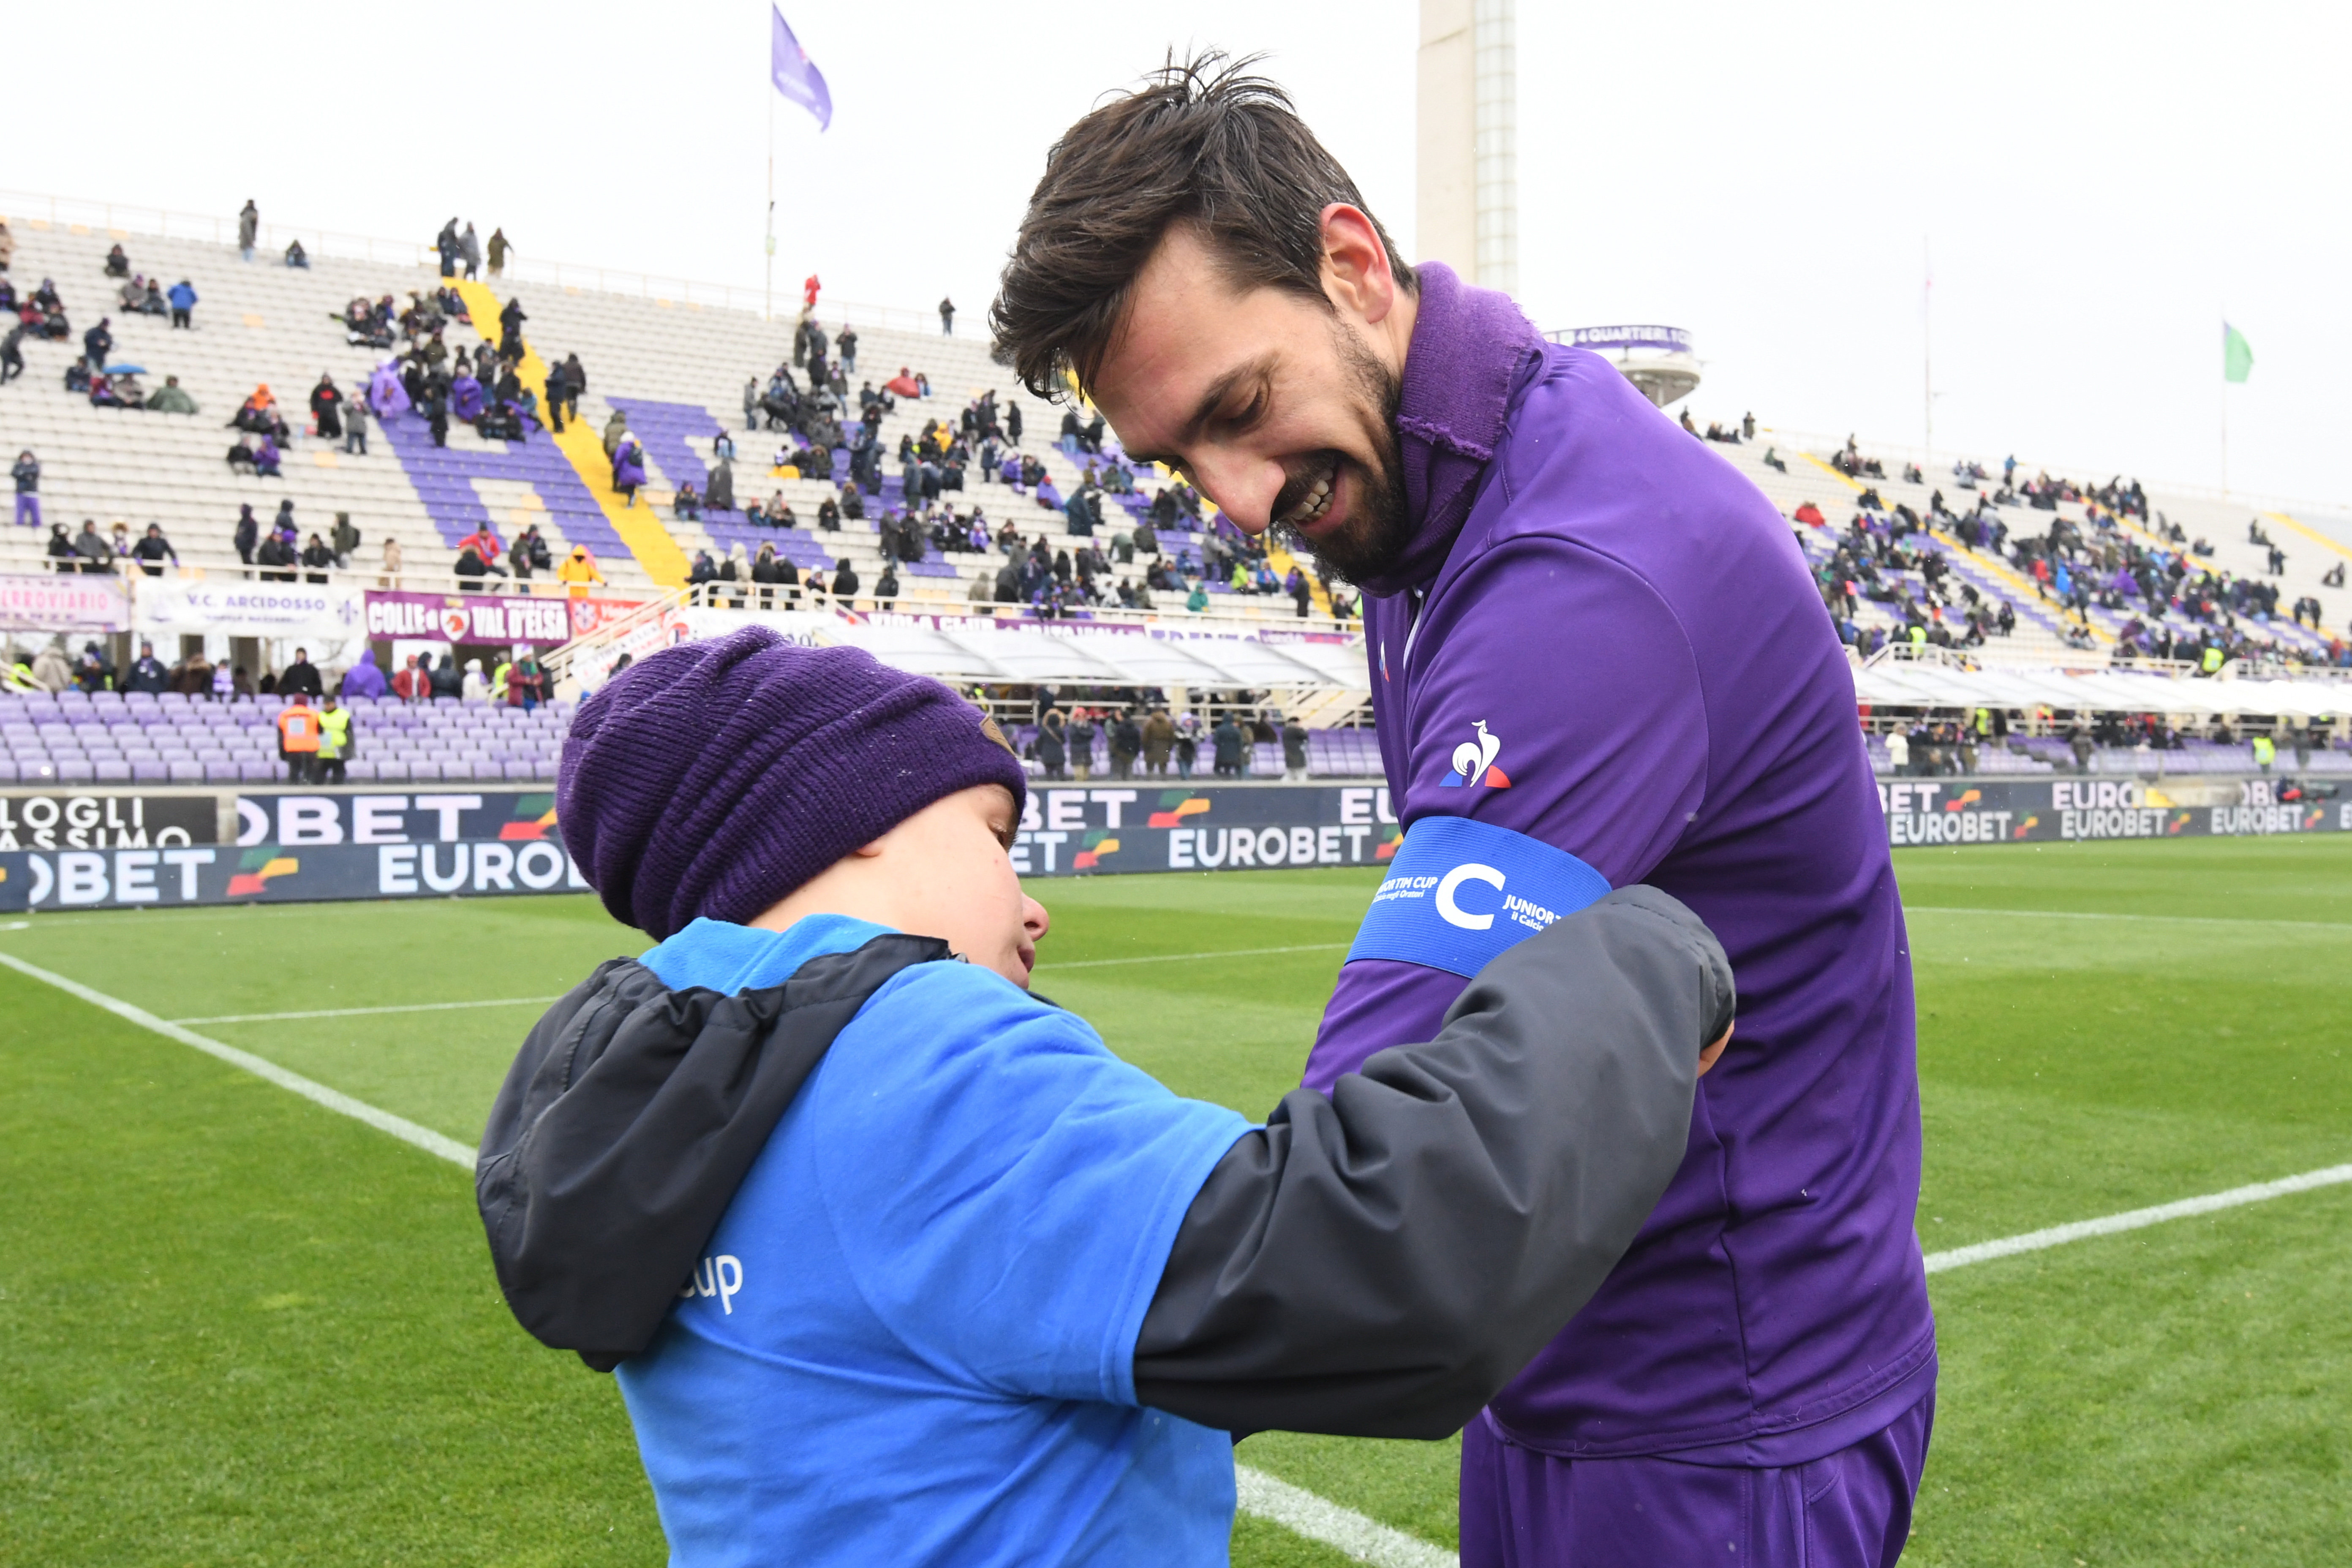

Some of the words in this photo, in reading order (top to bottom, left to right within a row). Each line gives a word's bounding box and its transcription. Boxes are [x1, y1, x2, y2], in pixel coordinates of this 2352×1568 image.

[226, 596, 326, 610] ARCIDOSSO
[368, 601, 426, 634] COLLE
[472, 606, 506, 637] VAL
[508, 607, 569, 640] D'ELSA
[0, 796, 143, 829] LOGLI
[1890, 810, 2013, 844] EUROBET
[2060, 808, 2169, 838] EUROBET
[2210, 803, 2304, 835] EUROBET
[1168, 825, 1372, 868] EUROBET
[378, 841, 591, 894] EURO
[1395, 877, 1413, 889] TIM
[1413, 877, 1438, 888] CUP
[1399, 890, 1425, 898] Oratori
[1435, 863, 1506, 930] C
[1502, 894, 1554, 924] JUNIOR
[1511, 911, 1519, 921] il
[676, 1254, 743, 1315] up
